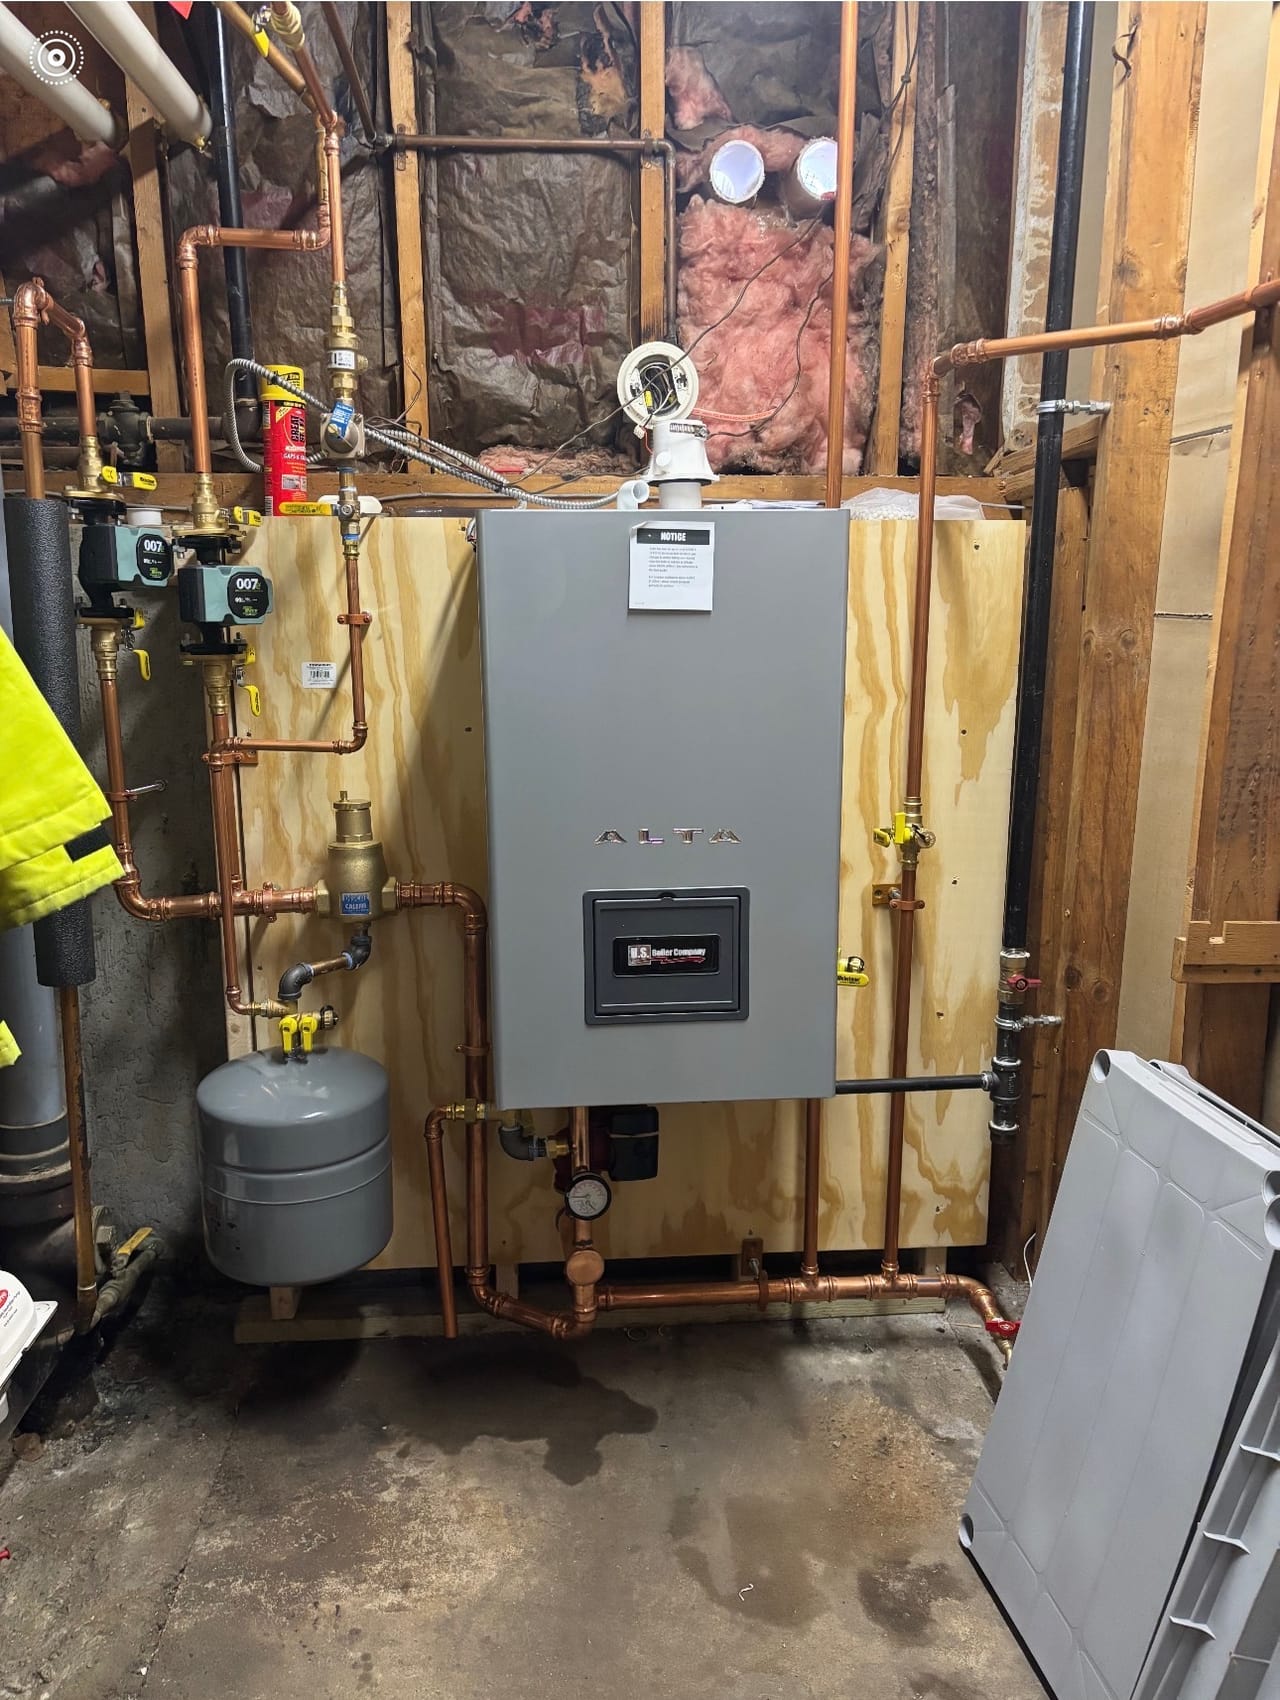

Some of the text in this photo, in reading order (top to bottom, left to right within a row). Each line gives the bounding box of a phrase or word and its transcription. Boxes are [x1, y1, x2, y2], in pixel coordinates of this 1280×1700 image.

[660, 531, 687, 542] NOTICE
[594, 827, 743, 845] ALTA
[630, 946, 707, 959] U.S. Boiler Company
